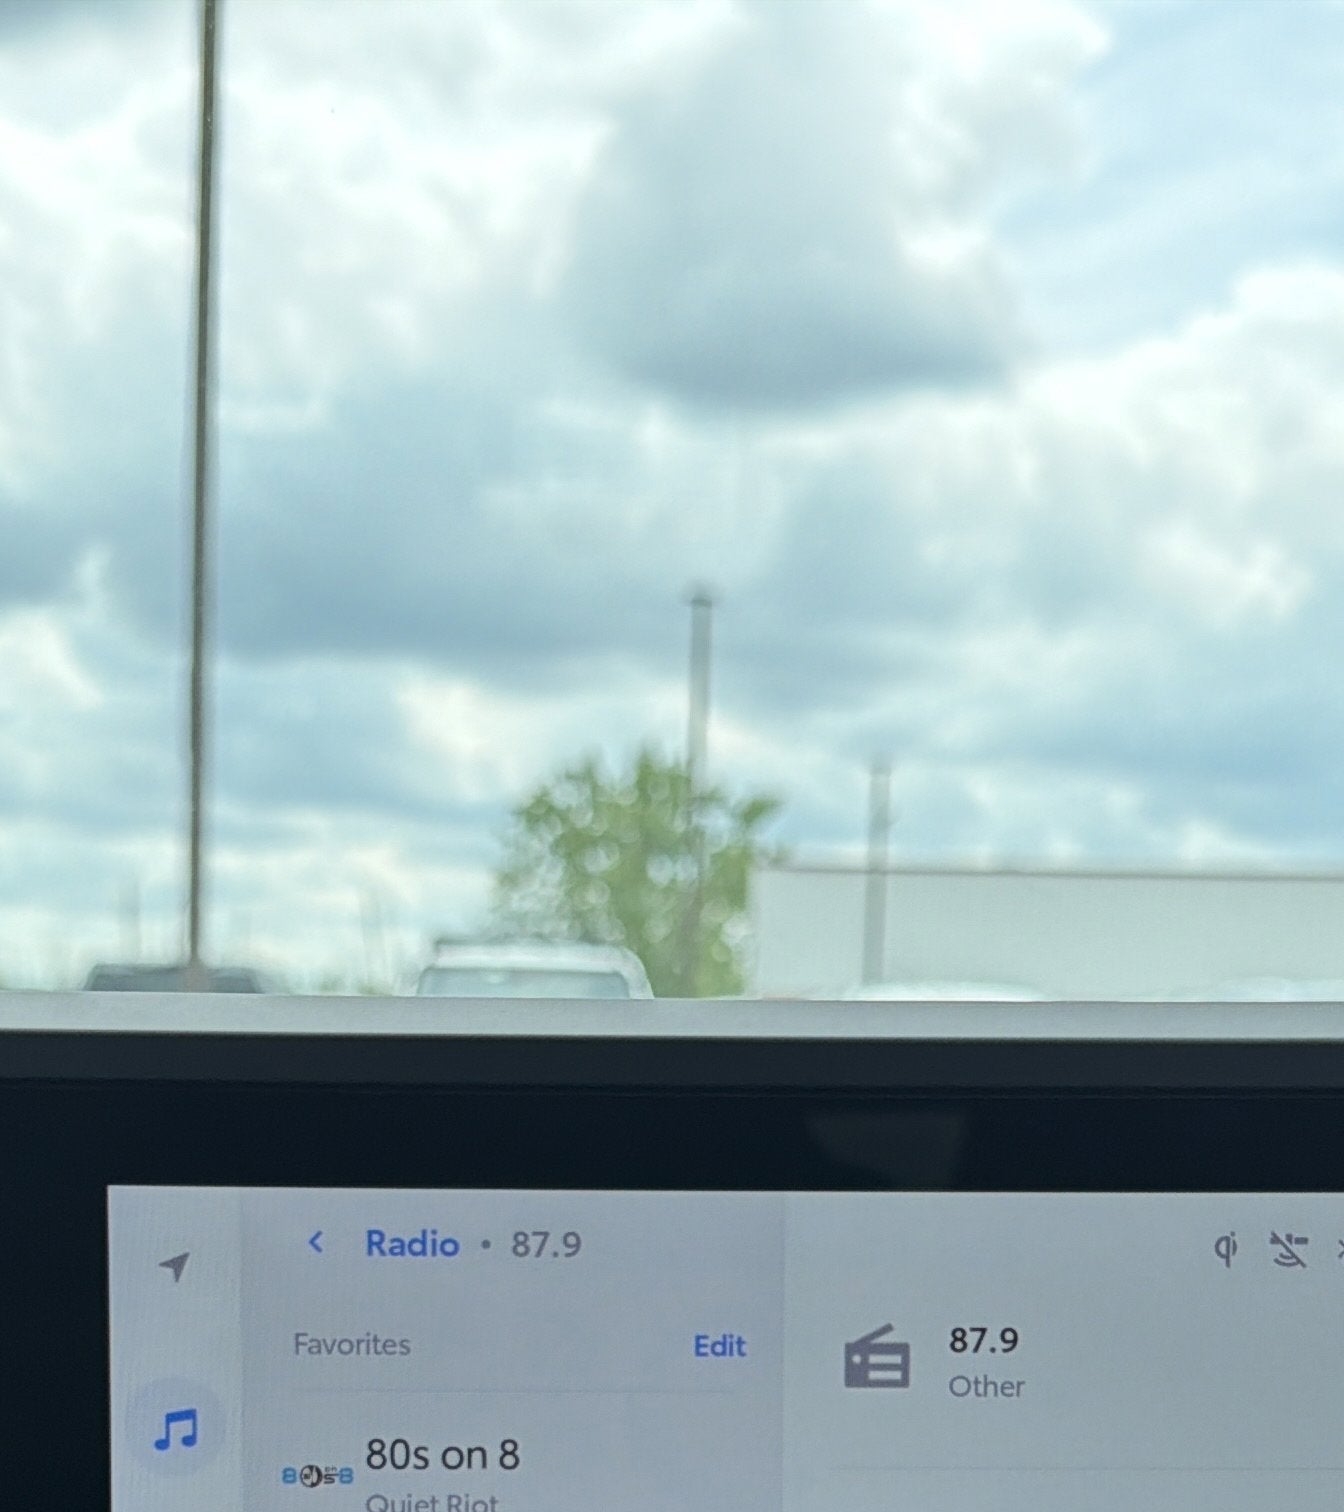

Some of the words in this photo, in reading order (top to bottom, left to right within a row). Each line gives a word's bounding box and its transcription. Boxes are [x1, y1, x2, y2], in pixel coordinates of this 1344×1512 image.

[366, 1228, 460, 1257] Radio
[511, 1230, 582, 1258] 87.9
[294, 1331, 411, 1356] Favorites
[694, 1333, 747, 1358] Edit
[949, 1327, 1019, 1354] 87.9
[948, 1374, 1026, 1398] Other
[366, 1438, 430, 1471] 80s
[441, 1446, 488, 1471] on
[499, 1438, 520, 1471] 8
